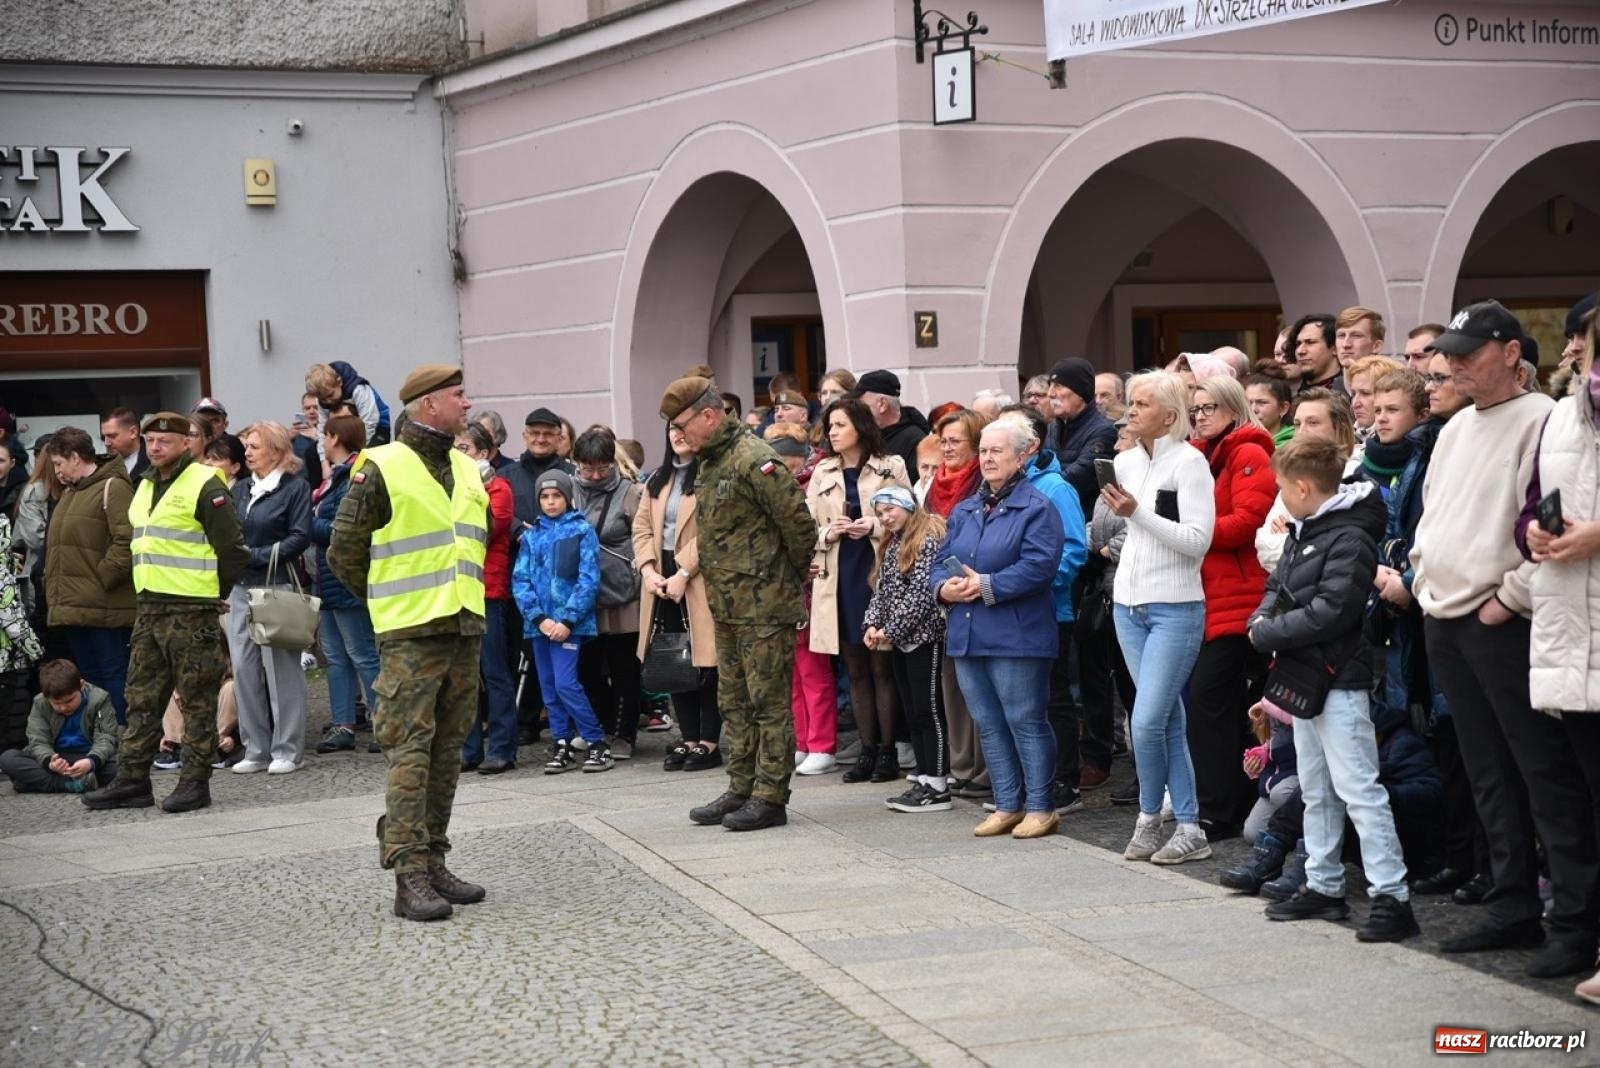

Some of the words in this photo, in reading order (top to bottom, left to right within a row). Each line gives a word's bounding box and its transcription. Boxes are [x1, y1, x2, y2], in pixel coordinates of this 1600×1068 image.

[1070, 21, 1095, 46] SALA
[1100, 6, 1185, 42] WIDOWISKOWA
[1466, 17, 1525, 43] Punkt
[1532, 19, 1600, 45] Inform
